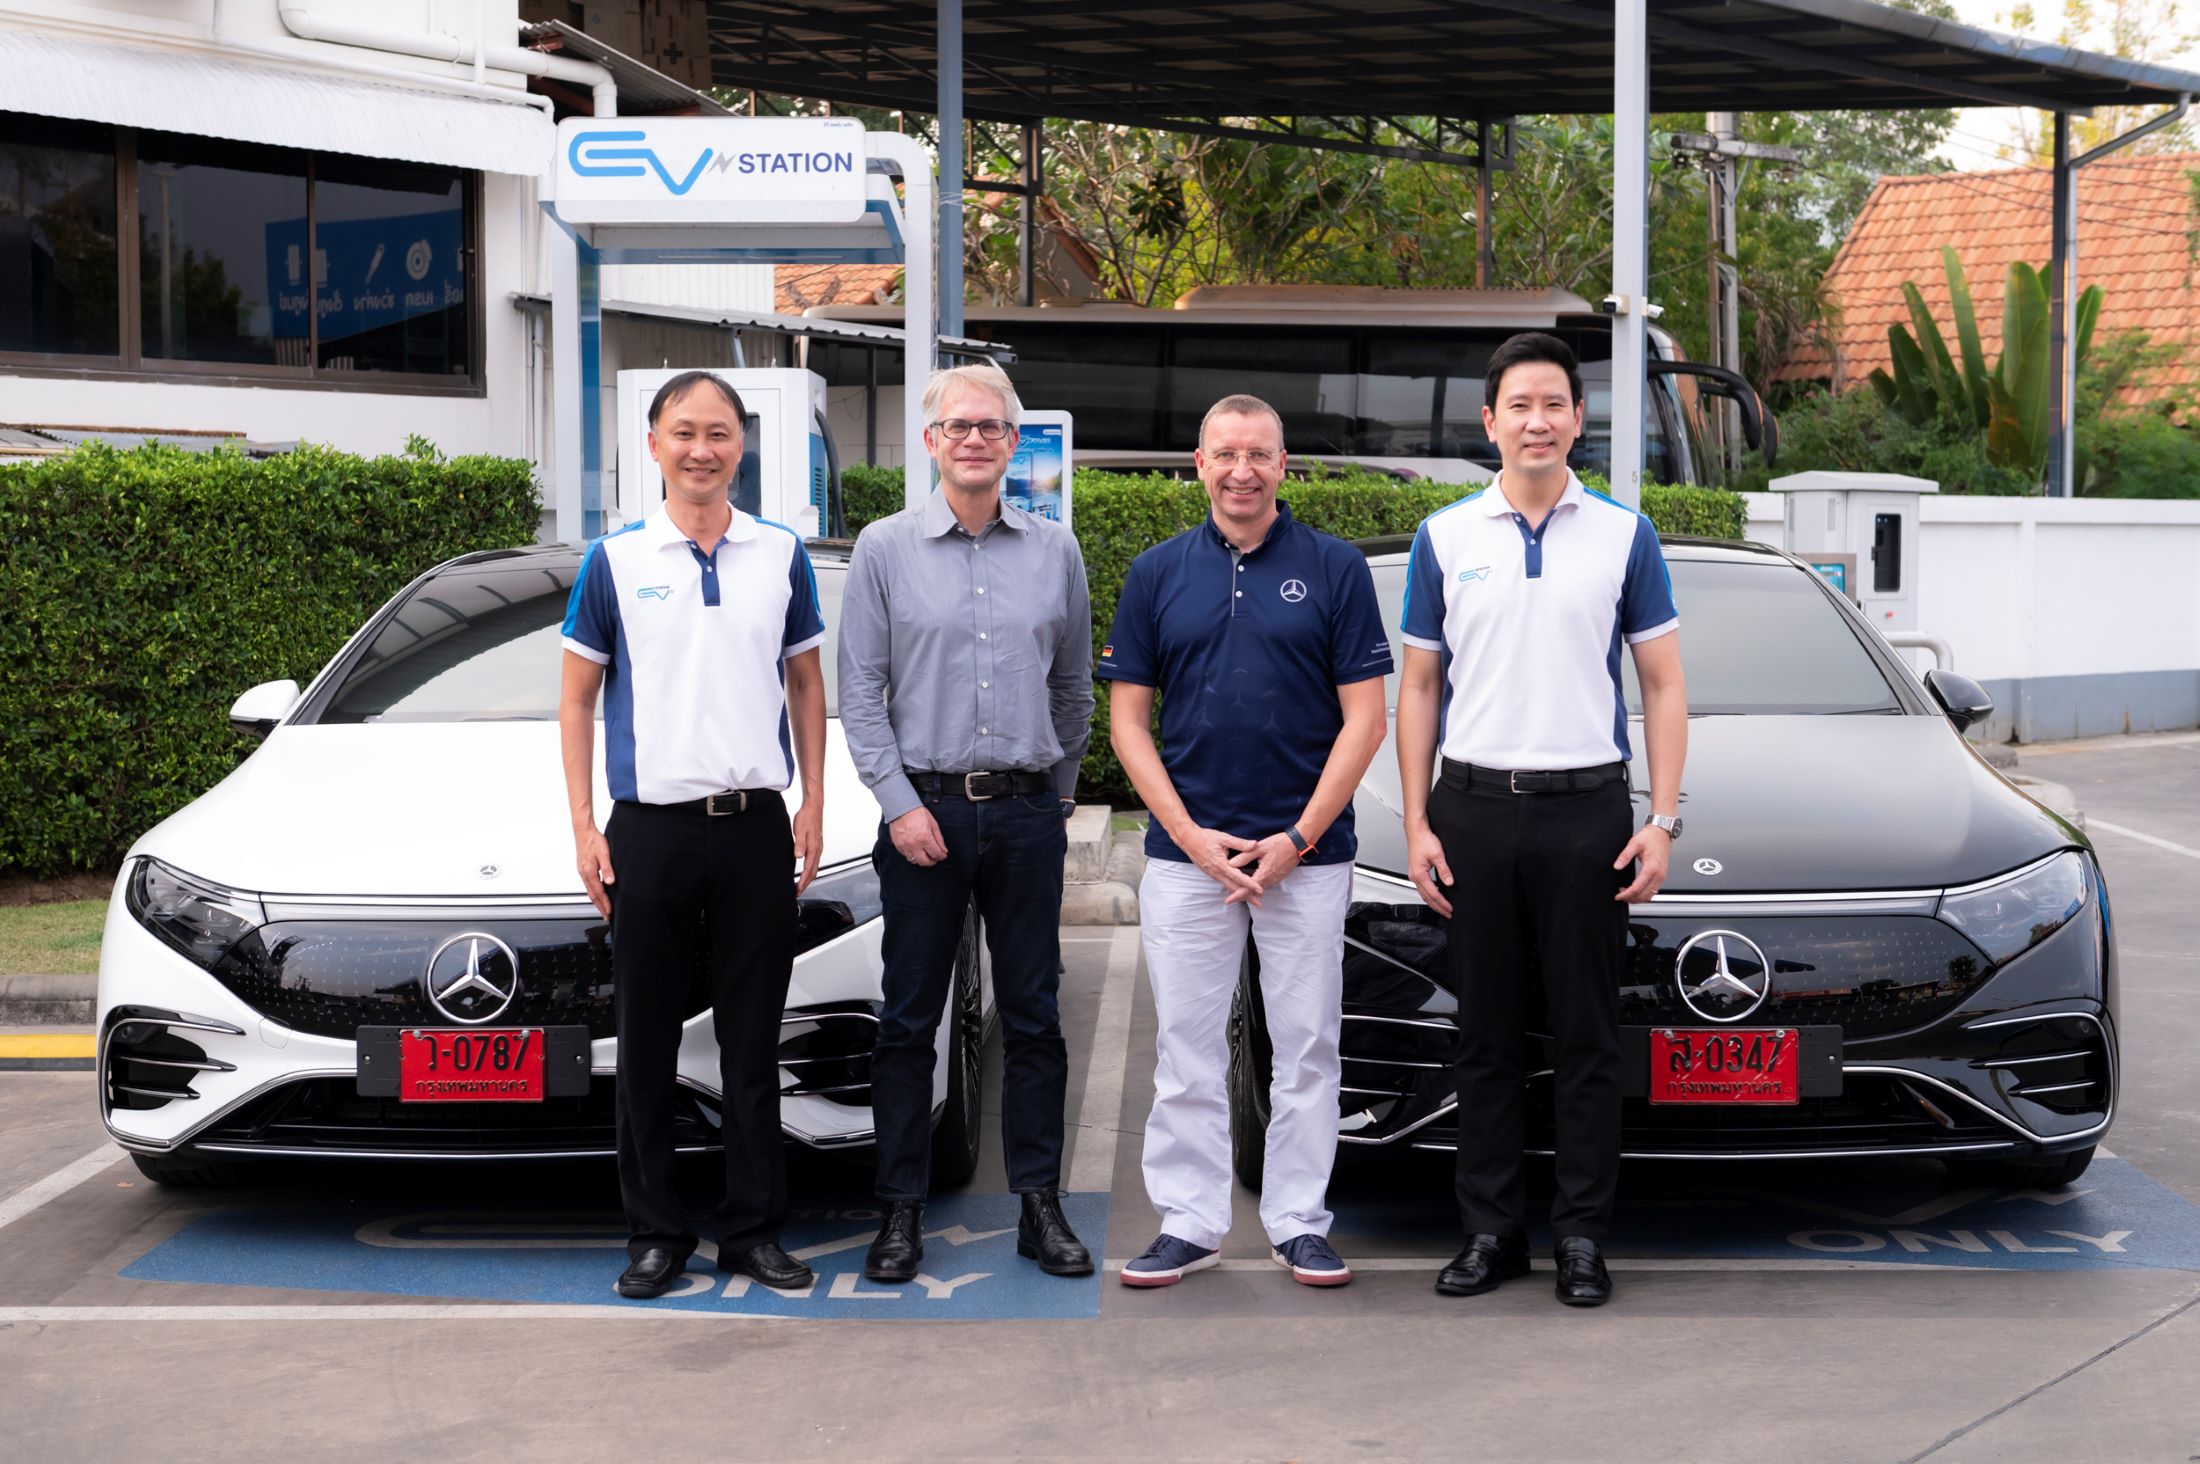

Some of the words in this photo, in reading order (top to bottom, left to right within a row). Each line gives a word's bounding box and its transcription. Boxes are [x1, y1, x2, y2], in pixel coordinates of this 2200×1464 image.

[568, 131, 713, 195] EV
[738, 152, 852, 173] STATION
[415, 1079, 529, 1098] กรุงเทพมหานคร
[1667, 1080, 1783, 1099] กรุงเทพมหานคร
[1786, 1229, 2135, 1254] ONLY
